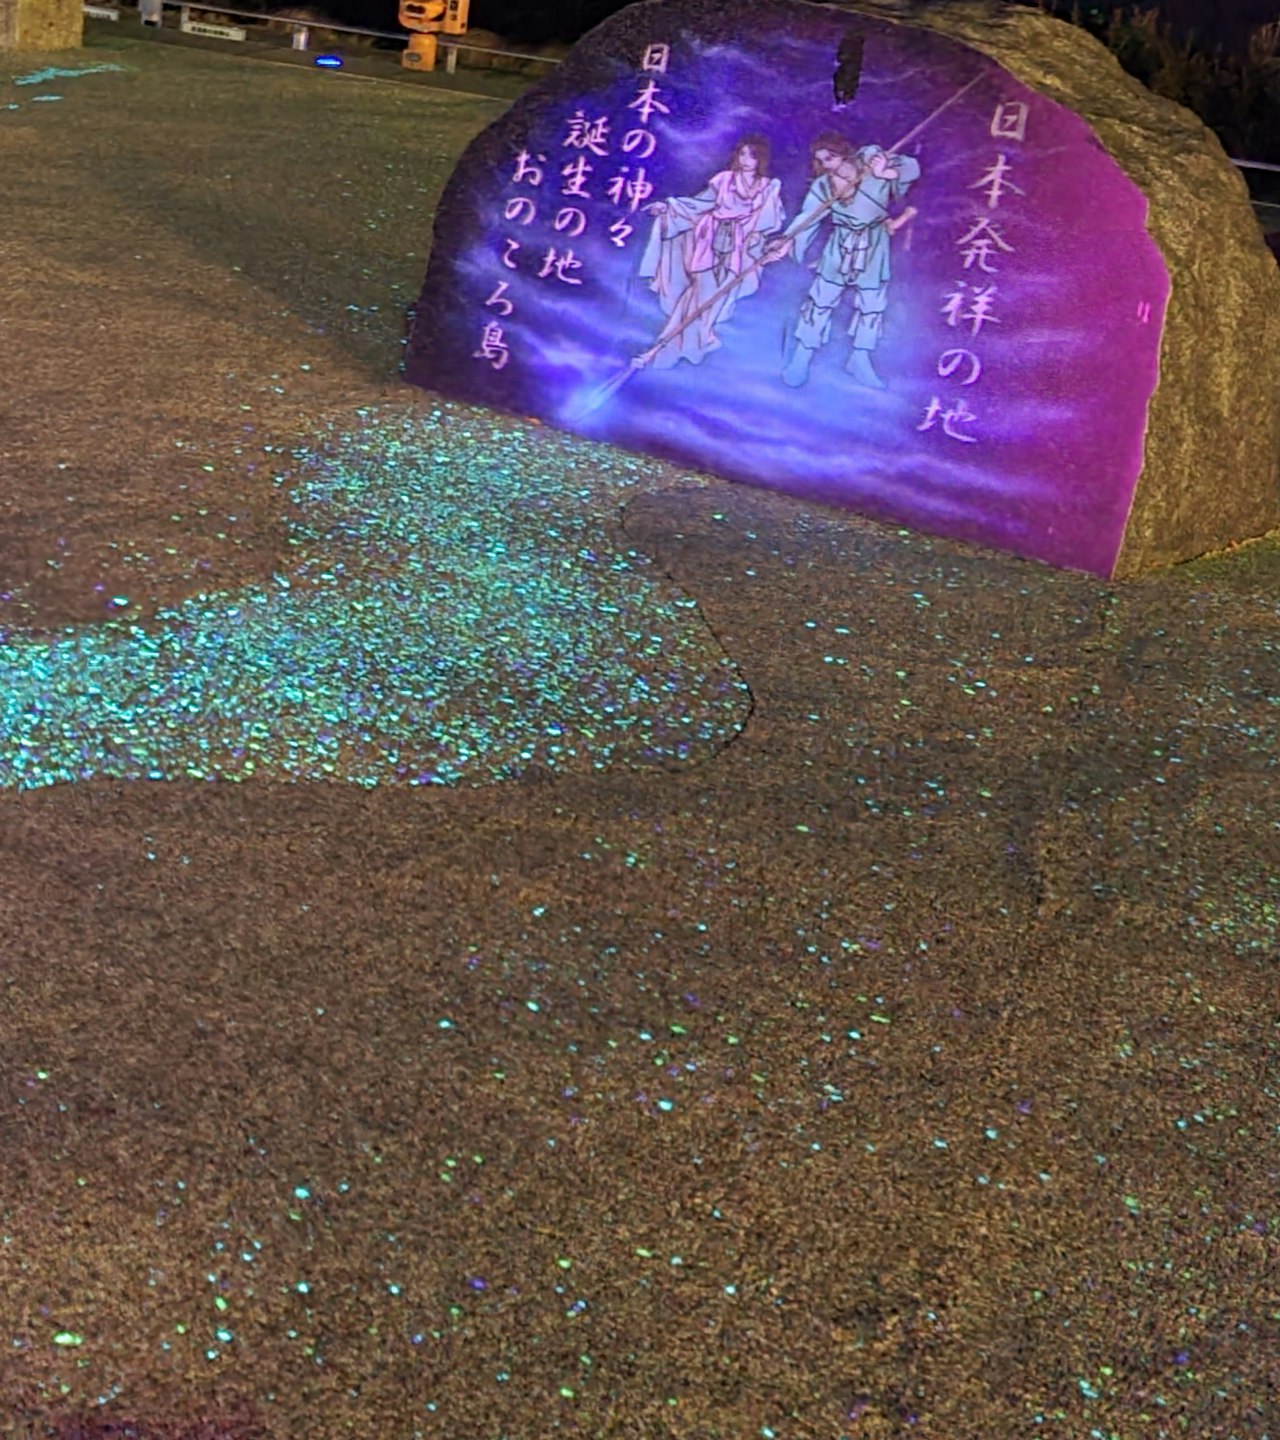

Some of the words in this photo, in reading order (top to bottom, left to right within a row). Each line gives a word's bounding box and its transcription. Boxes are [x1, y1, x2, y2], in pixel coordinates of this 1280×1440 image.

[538, 110, 610, 285] 誕生の地
[606, 42, 671, 248] 日本の神々
[472, 149, 546, 370] おのころ島
[916, 100, 1028, 444] 日本発祥の地
